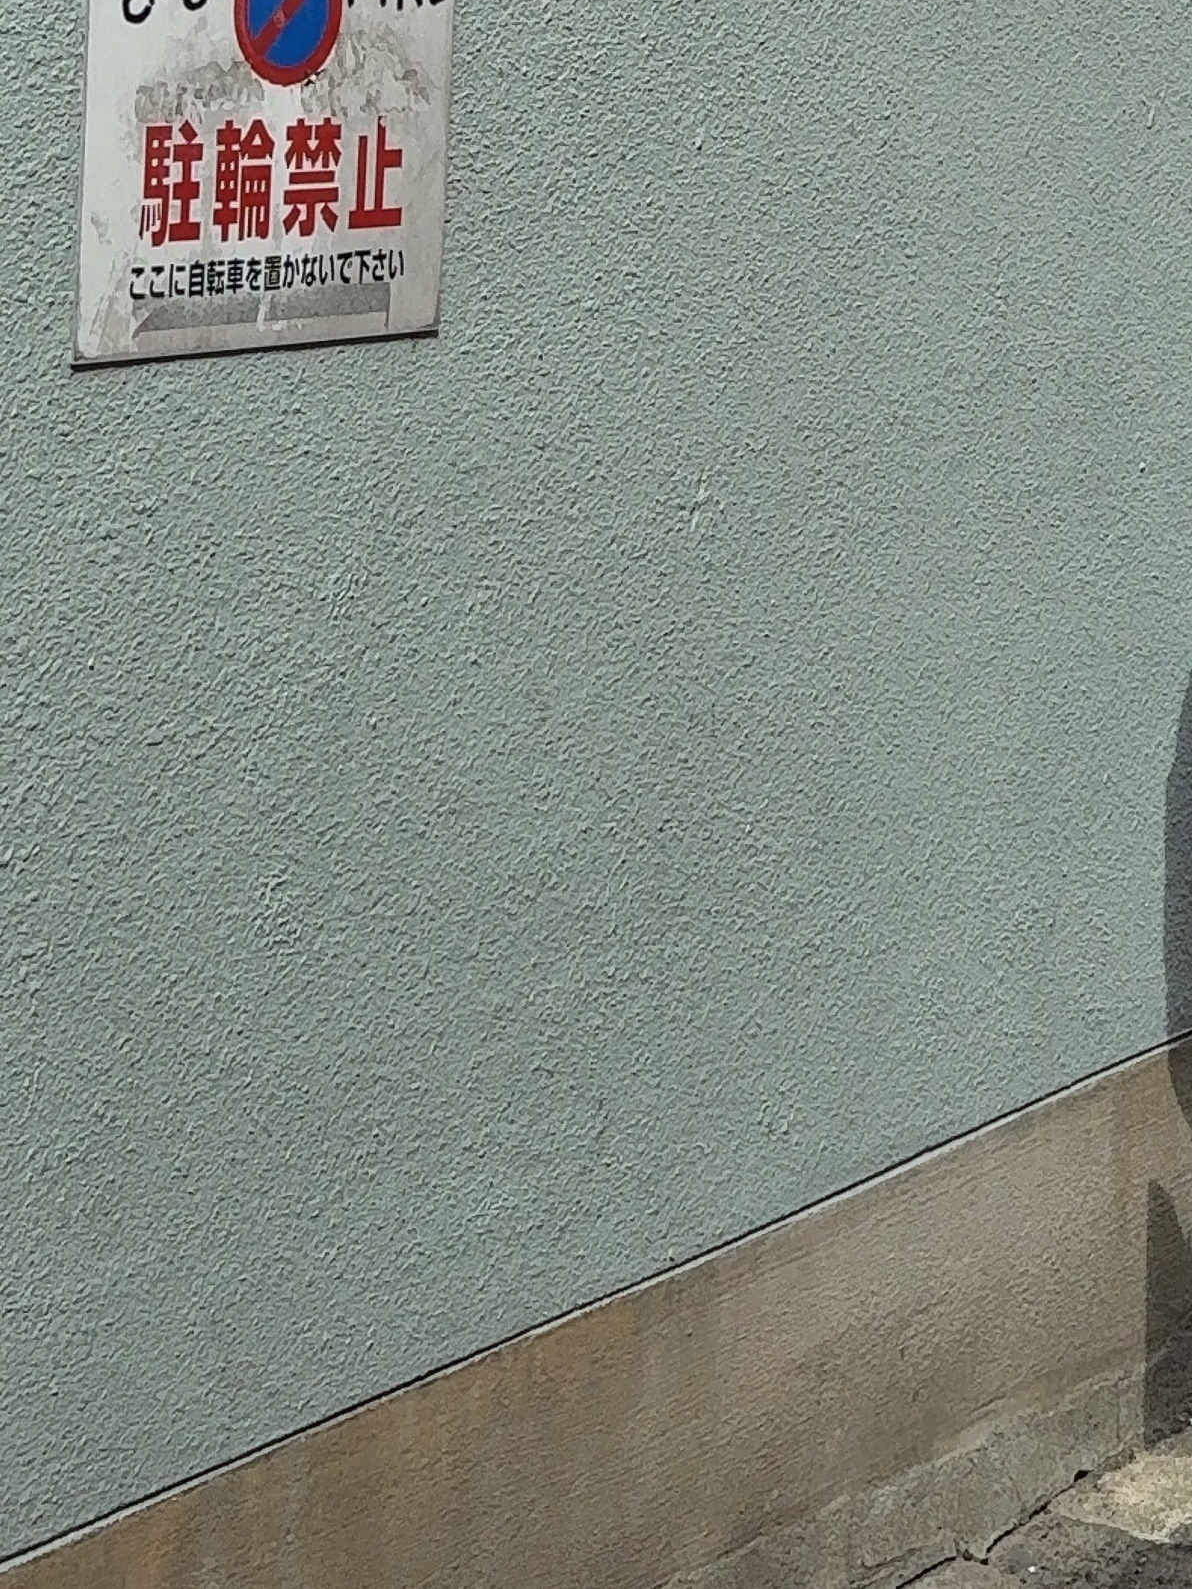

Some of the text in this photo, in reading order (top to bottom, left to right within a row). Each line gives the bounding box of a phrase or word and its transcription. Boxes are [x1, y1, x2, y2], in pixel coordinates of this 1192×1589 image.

[138, 116, 404, 247] 駐輪禁止
[129, 248, 405, 300] ここに自転車を置かないで下さい
